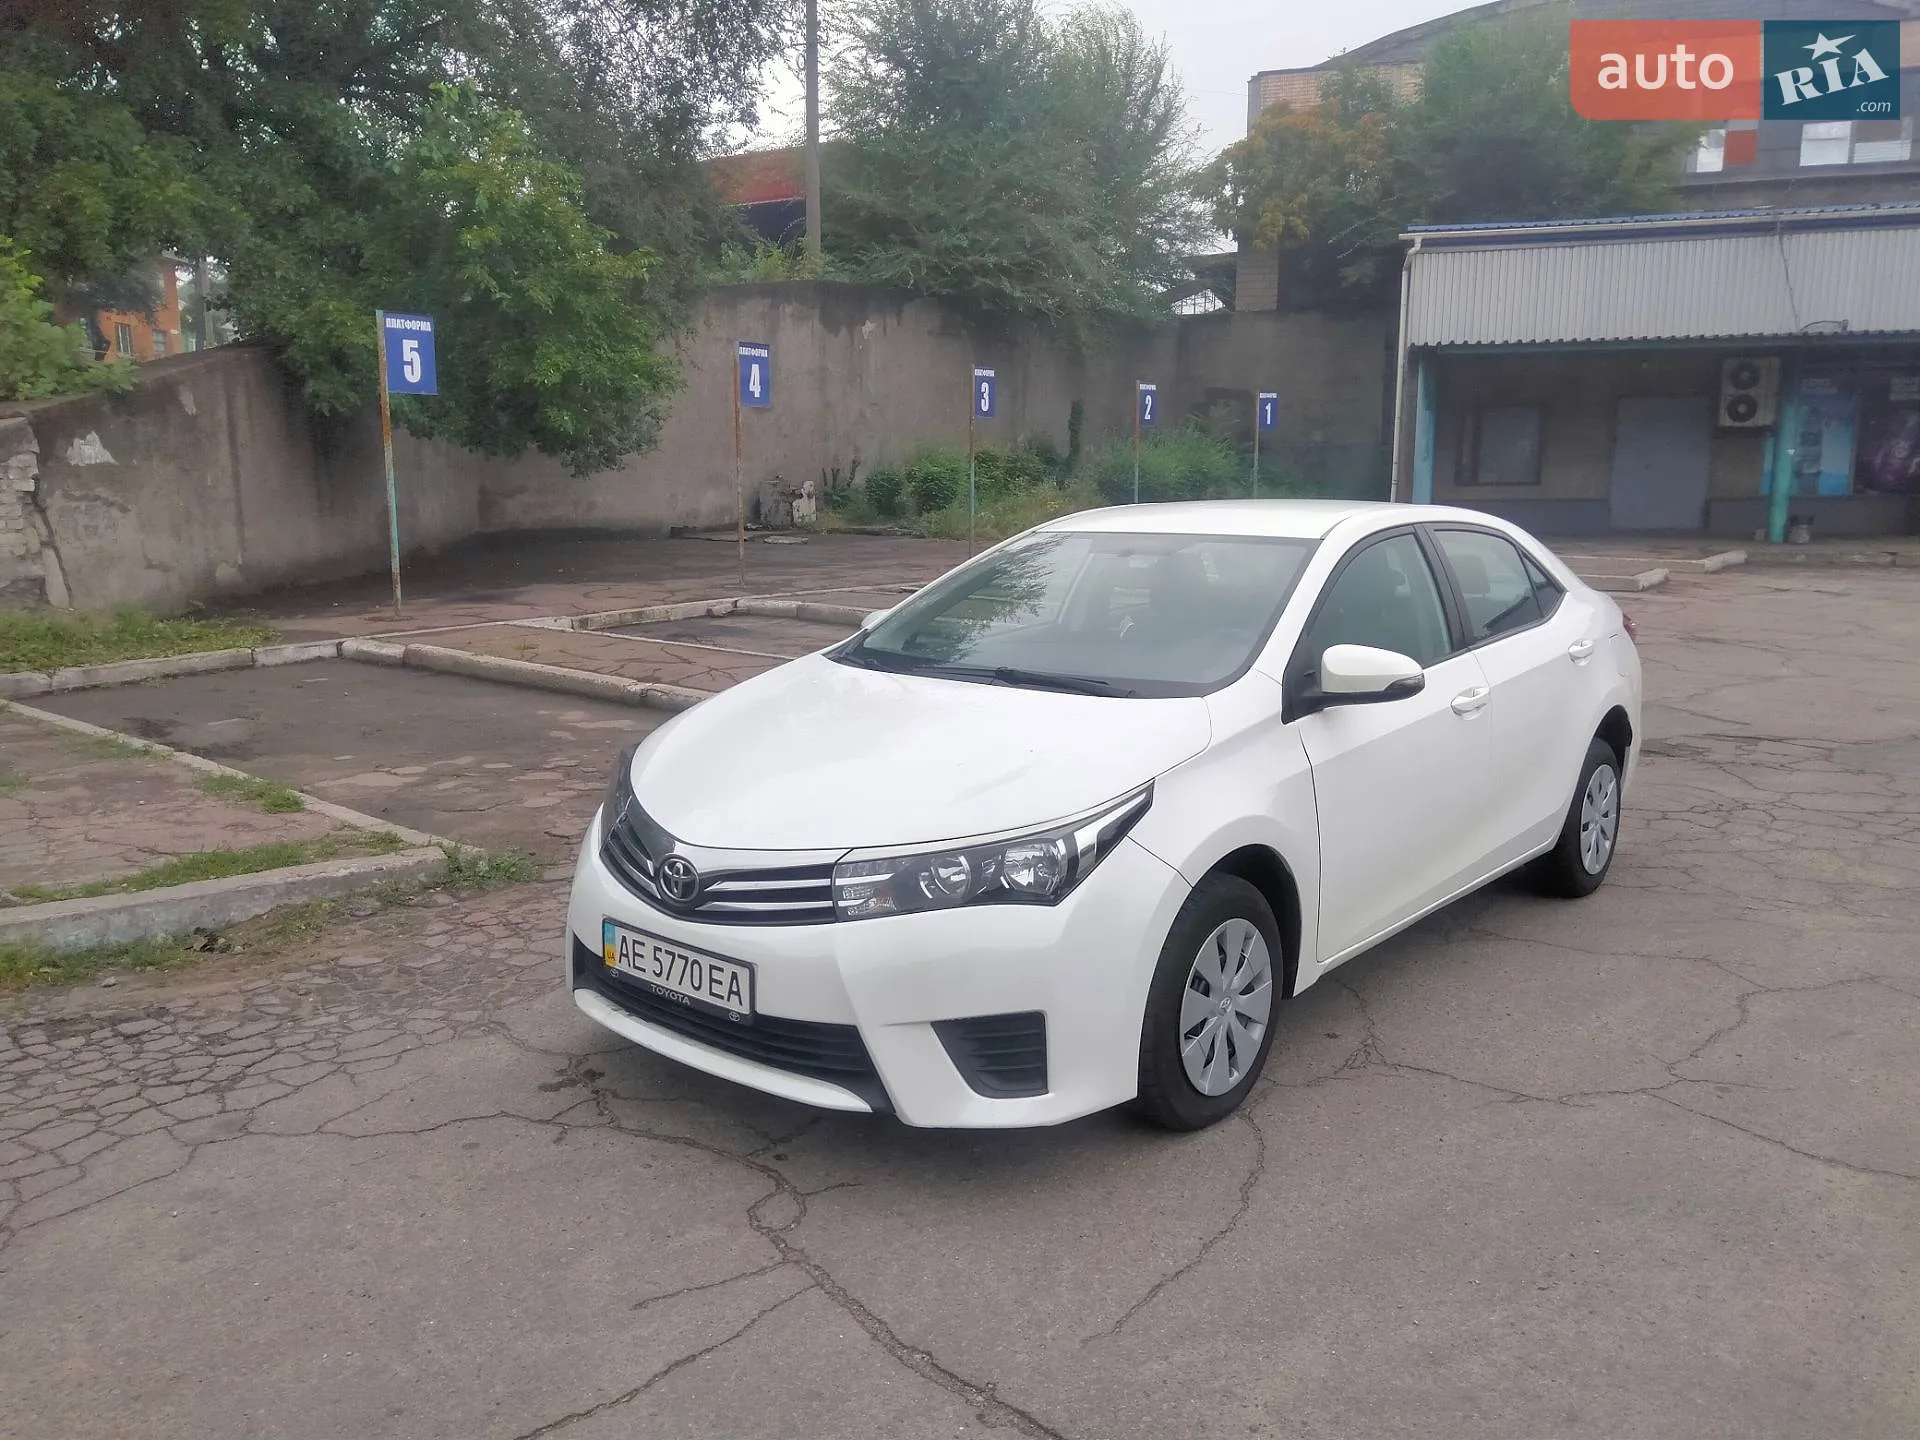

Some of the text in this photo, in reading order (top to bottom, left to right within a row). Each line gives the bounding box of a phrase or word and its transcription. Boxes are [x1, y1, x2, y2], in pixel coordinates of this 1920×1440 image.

[385, 317, 432, 332] ПЛАТФОРМА
[402, 339, 421, 383] 5
[749, 364, 761, 398] 4
[981, 382, 990, 412] 3
[1144, 394, 1152, 420] 2
[1265, 402, 1271, 425] 1
[606, 950, 616, 962] UA
[618, 935, 743, 1006] AE 5770 EA
[650, 983, 691, 1006] TOYOTA
